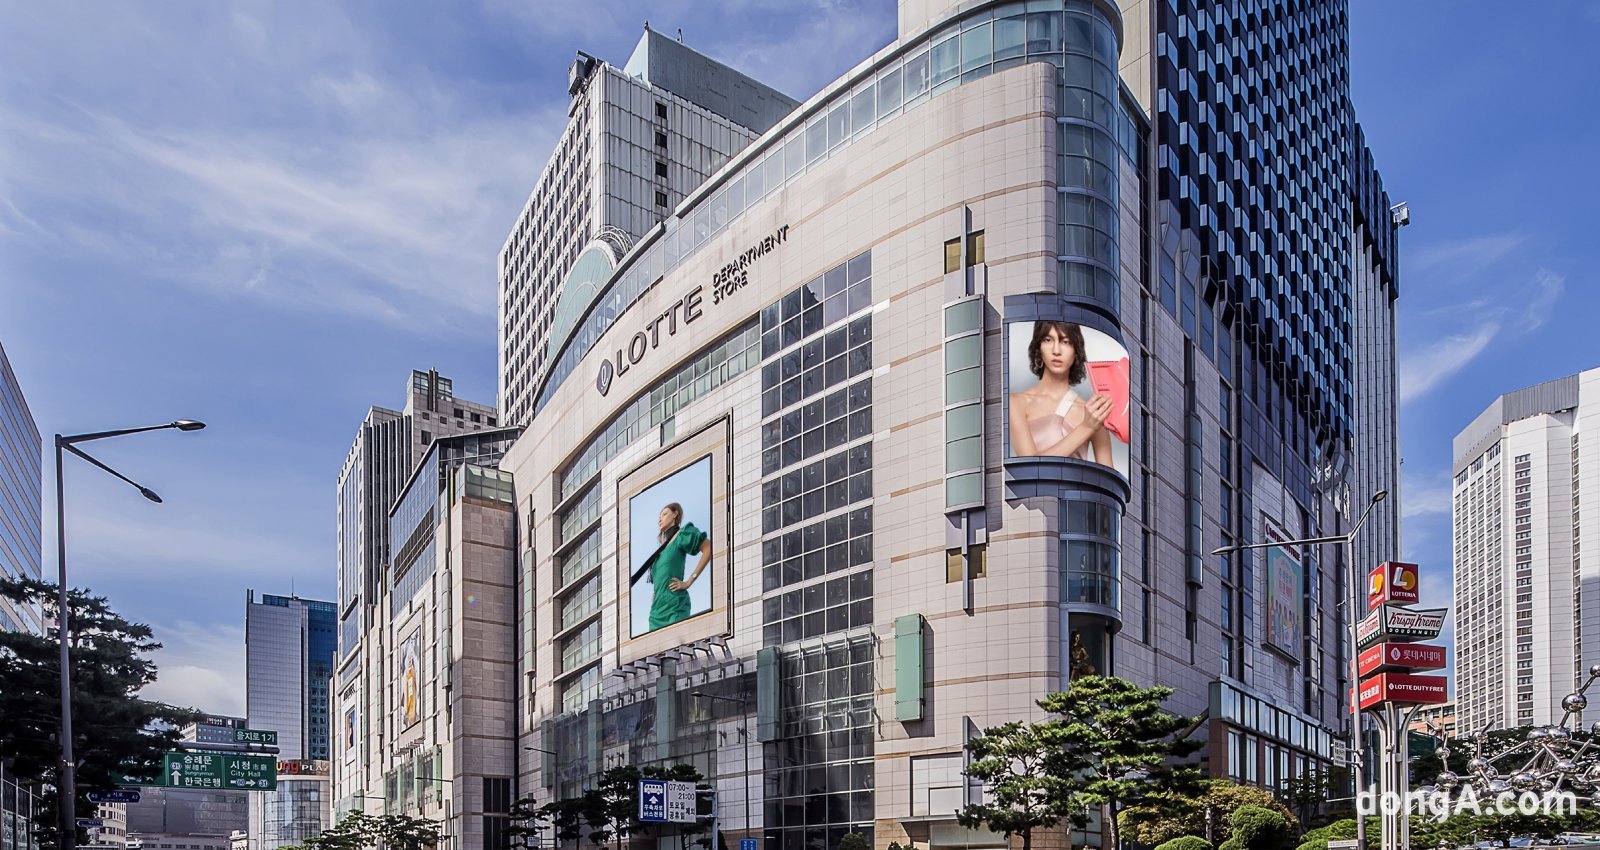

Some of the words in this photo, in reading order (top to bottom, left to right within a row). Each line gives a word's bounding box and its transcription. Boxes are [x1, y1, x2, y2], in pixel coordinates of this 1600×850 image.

[713, 224, 789, 288] DEPARTMENT
[712, 270, 748, 305] STORE
[616, 285, 703, 378] LOTTE
[1389, 612, 1416, 629] Krispy
[1415, 614, 1441, 628] Kreme
[1389, 628, 1439, 636] DOUGHNUTS
[1403, 649, 1441, 661] 롯데시네마
[237, 731, 260, 741] 을지로
[183, 755, 212, 765] 숭례문
[230, 760, 250, 770] 시청
[184, 777, 221, 787] 한국은행
[669, 811, 685, 819] 공휴일
[685, 807, 696, 816] 제외
